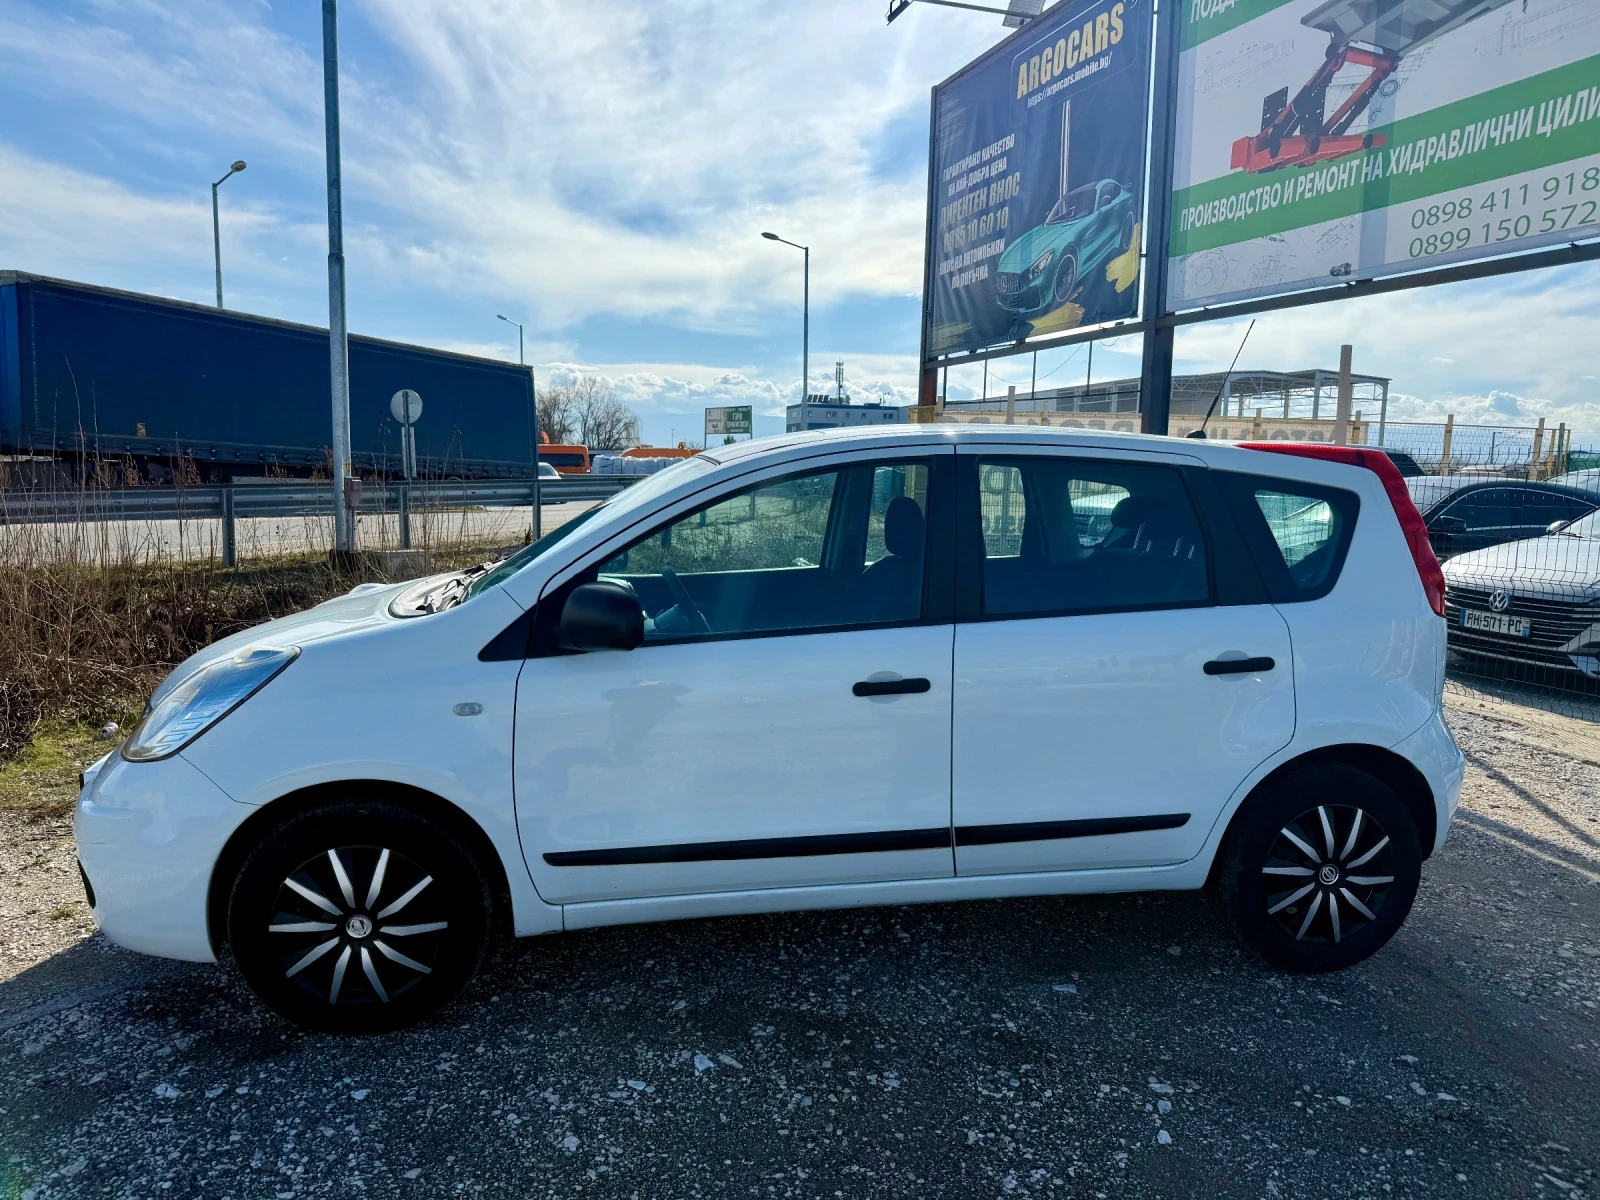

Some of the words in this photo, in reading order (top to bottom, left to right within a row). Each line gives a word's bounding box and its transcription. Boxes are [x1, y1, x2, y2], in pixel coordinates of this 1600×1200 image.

[1017, 2, 1124, 100] ARGOCARS
[982, 133, 1015, 162] КАЧЕСТВО
[990, 156, 1007, 178] ЦЕНА
[1180, 182, 1281, 232] ПРОИЗВОДСТВО
[1283, 178, 1295, 205] И
[1296, 158, 1360, 202] РЕМОНТ
[1361, 151, 1383, 184] НА
[1386, 105, 1535, 177] ХИДРАВЛИЧНИ
[940, 186, 988, 232] ДИРЕКТЕН
[988, 171, 1020, 207] ВНОС
[980, 212, 994, 238] 60
[996, 206, 1008, 232] 10
[1411, 197, 1473, 230] 0898
[1480, 183, 1529, 213] 411
[1542, 166, 1600, 201] 918
[1409, 227, 1471, 258] 0899
[1481, 214, 1531, 244] 150
[1539, 200, 1597, 233] 572
